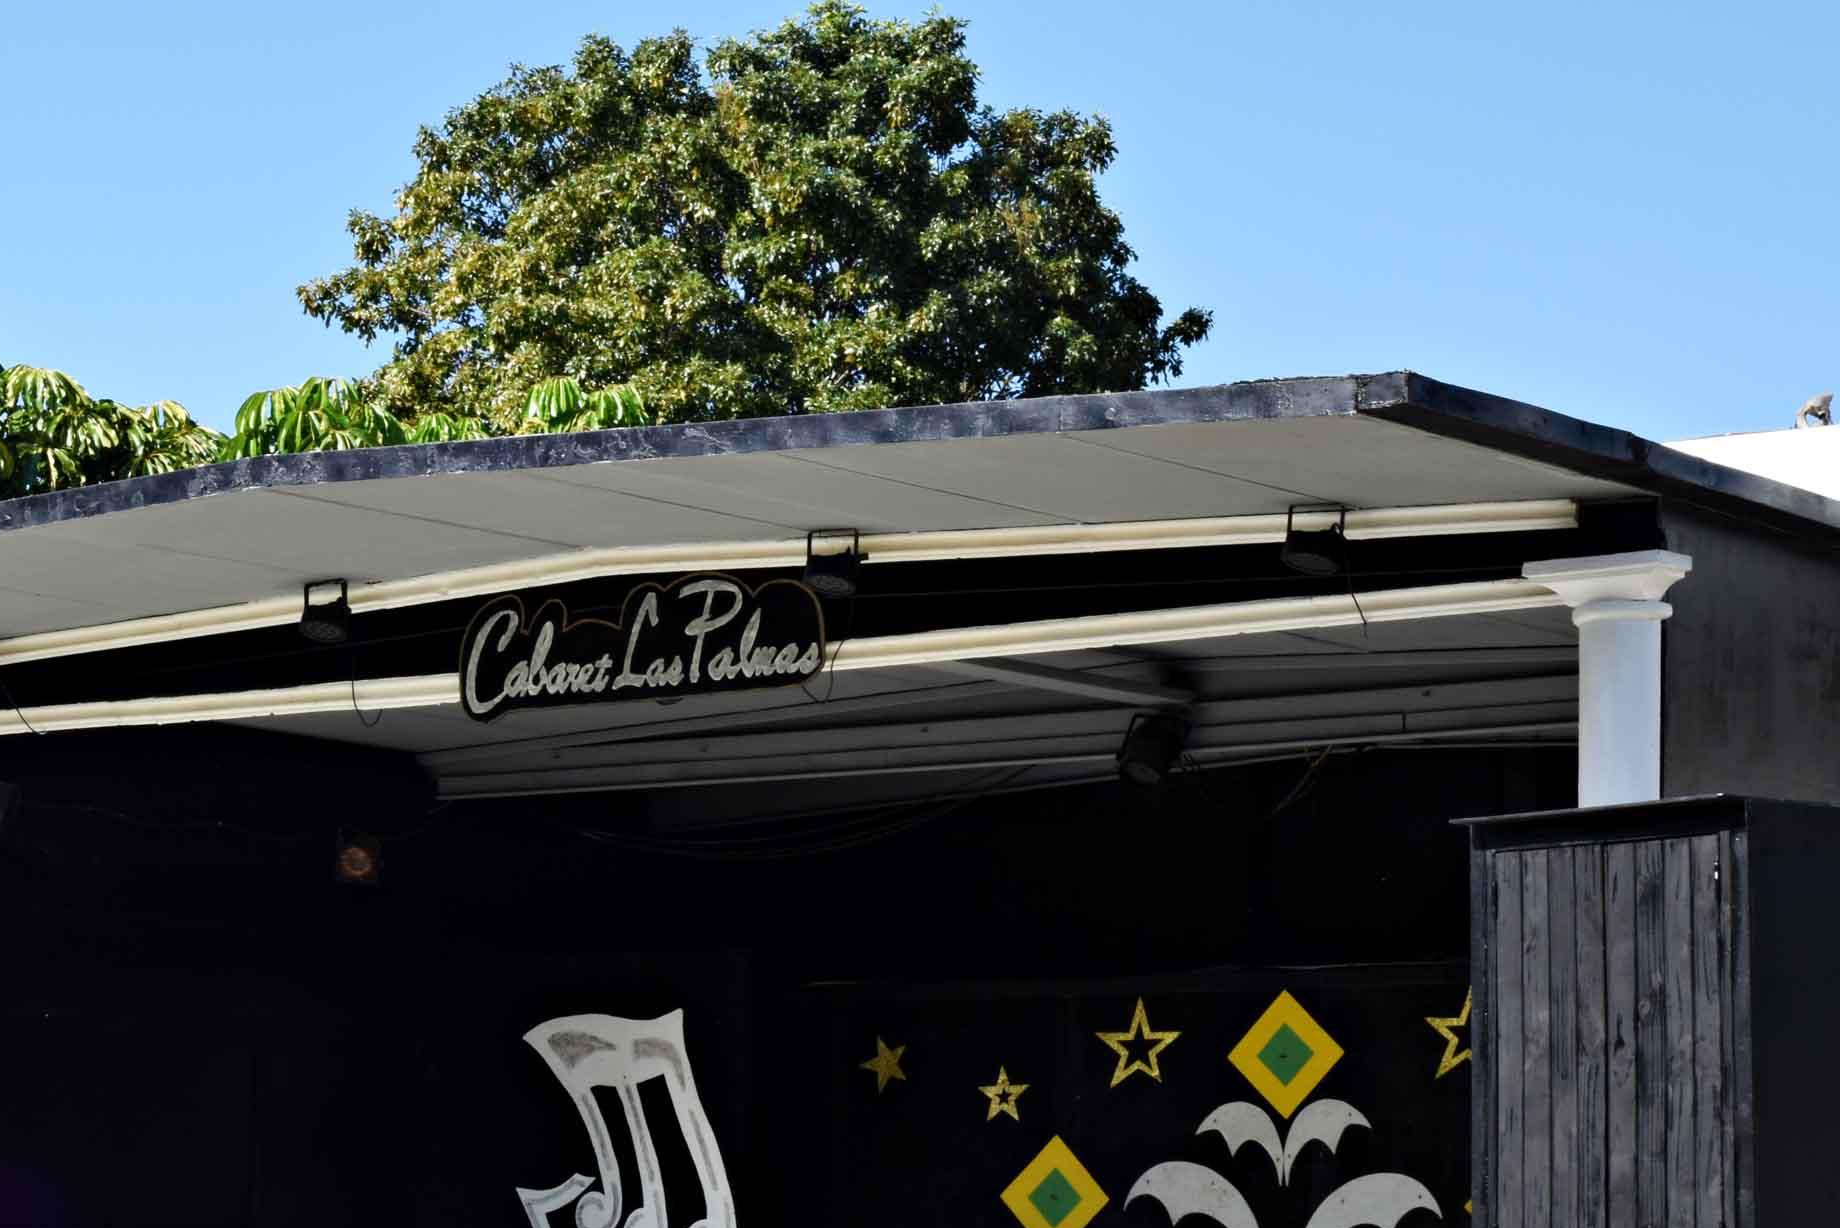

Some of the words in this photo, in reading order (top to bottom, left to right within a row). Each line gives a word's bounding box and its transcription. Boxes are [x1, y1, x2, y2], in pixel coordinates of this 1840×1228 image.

[466, 609, 614, 714] Cabaret
[613, 592, 684, 690] Las
[679, 579, 821, 683] Palmas
